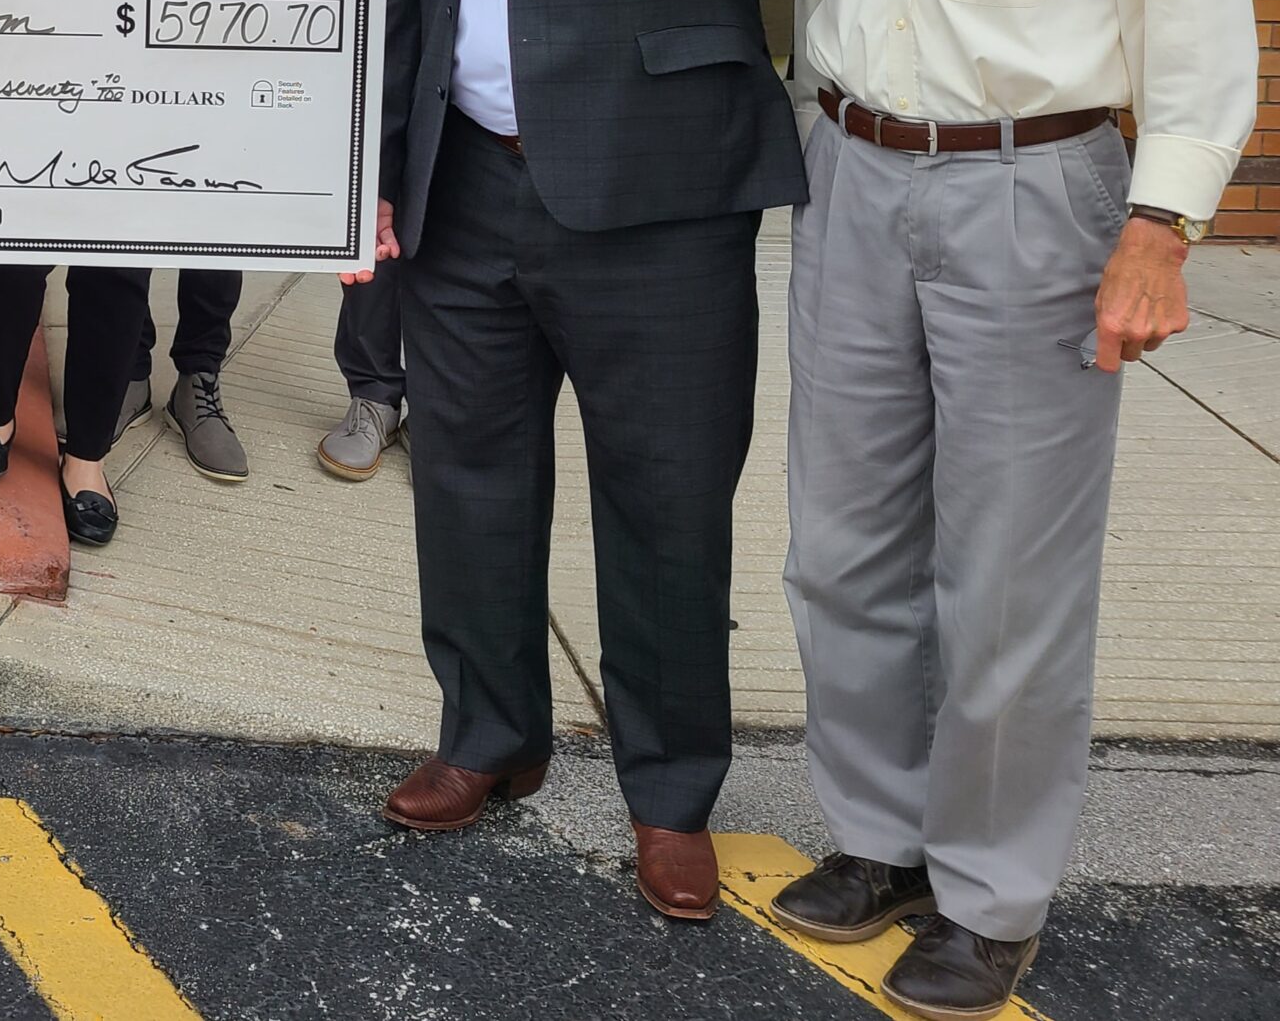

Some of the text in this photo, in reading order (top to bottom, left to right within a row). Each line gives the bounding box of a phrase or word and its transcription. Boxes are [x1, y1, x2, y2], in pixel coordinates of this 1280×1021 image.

[115, 1, 136, 38] $
[155, 0, 336, 46] 5970.70
[278, 80, 303, 88] Security
[278, 87, 305, 95] Features
[131, 89, 225, 105] DOLLARS
